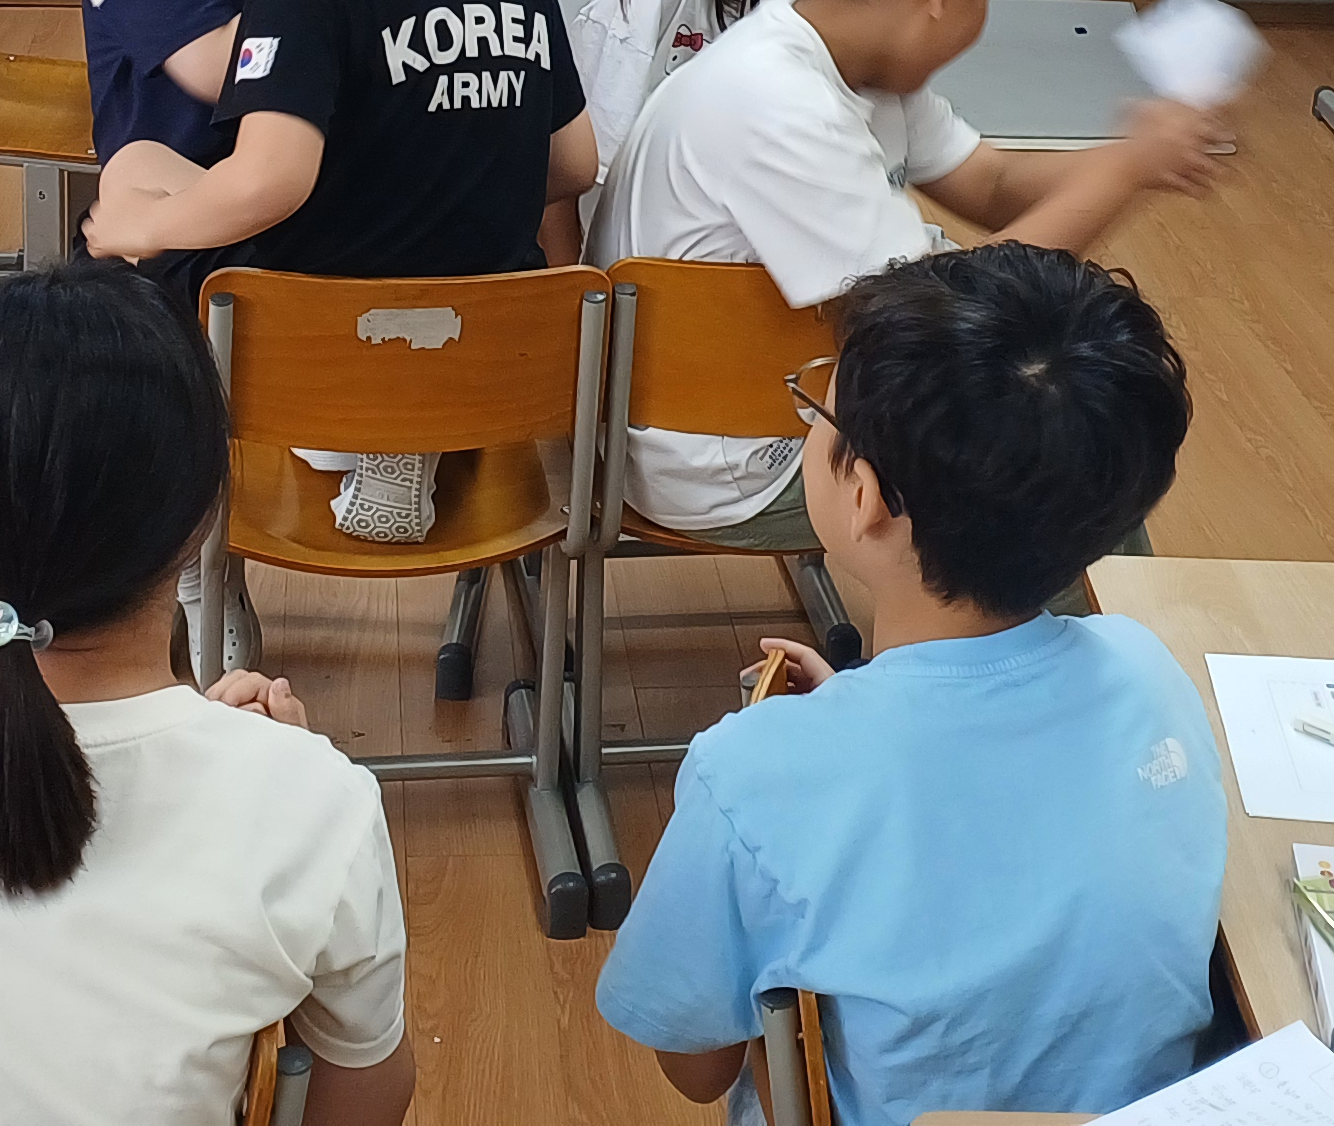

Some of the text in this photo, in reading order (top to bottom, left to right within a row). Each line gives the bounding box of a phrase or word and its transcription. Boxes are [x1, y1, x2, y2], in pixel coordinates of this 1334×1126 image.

[382, 1, 552, 86] KOREA
[427, 70, 526, 113] ARMY
[1137, 753, 1174, 782] NORTH
[1150, 767, 1177, 791] FACE
